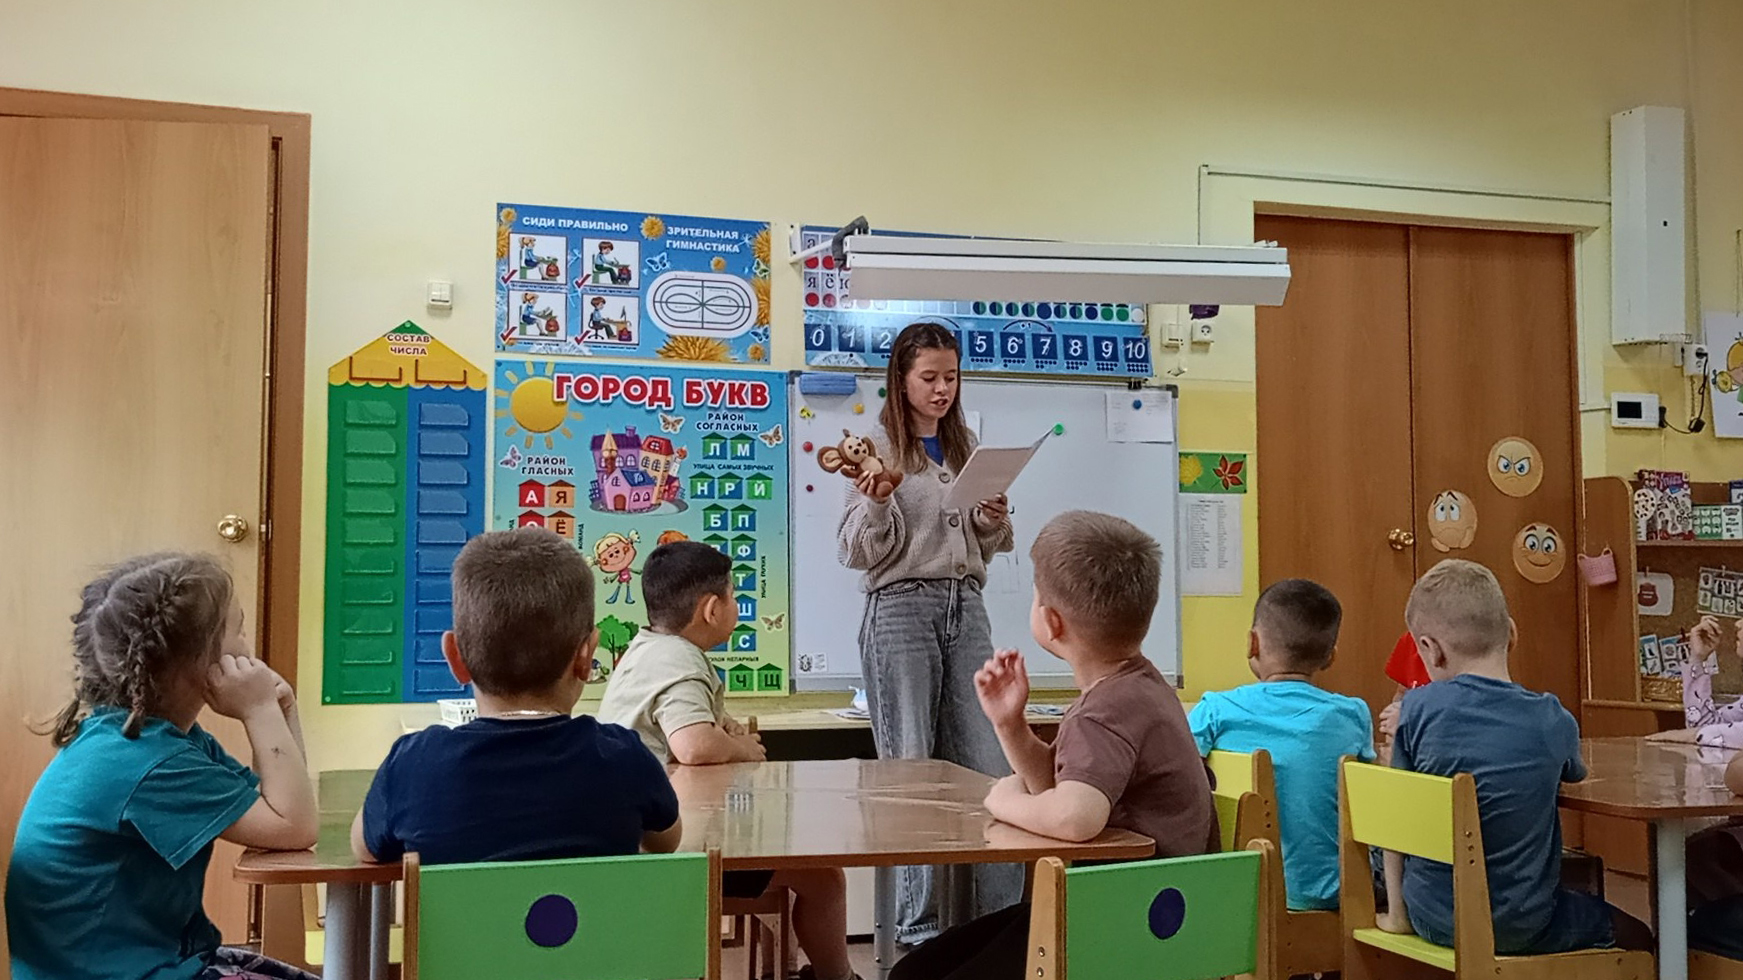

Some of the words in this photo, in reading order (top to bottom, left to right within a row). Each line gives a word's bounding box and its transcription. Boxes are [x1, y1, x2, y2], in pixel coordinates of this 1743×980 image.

[522, 216, 556, 229] СИДИ
[558, 218, 628, 232] ПРАВИЛЬНО
[667, 226, 739, 240] ЗРИТЕЛЬНАЯ
[665, 240, 740, 254] ГИМНАСТИКА
[807, 276, 816, 288] я
[825, 273, 835, 289] ё
[387, 334, 430, 343] СОСТАВ
[811, 328, 825, 347] 0
[843, 328, 856, 348] 1
[880, 332, 892, 350] 2
[974, 335, 987, 353] 5
[1007, 336, 1019, 354] 6
[1039, 338, 1051, 355] 7
[1070, 339, 1082, 356] 8
[1101, 340, 1113, 358] 9
[1125, 341, 1146, 359] 10
[390, 346, 427, 355] ЧИСЛА
[555, 375, 673, 408] ГОРОД
[685, 380, 769, 407] БУКВ
[708, 411, 745, 421] РАЙОН
[696, 421, 759, 432] СОГЛАСНЫХ
[708, 442, 721, 456] Л
[736, 443, 750, 457] М
[527, 456, 566, 465] РАЙОН
[521, 467, 575, 476] ГЛАСНЫХ
[696, 482, 708, 496] Н
[725, 482, 736, 496] Р
[754, 480, 766, 496] Й
[525, 489, 540, 504] А
[556, 490, 568, 503] Я
[555, 519, 567, 535] Ё
[710, 514, 722, 528] Б
[738, 514, 750, 528] П
[737, 544, 752, 558] Ф
[735, 573, 747, 587] Т
[737, 603, 752, 616] Ш
[738, 635, 751, 648] С
[735, 674, 747, 688] Ч
[764, 673, 781, 689] Щ
